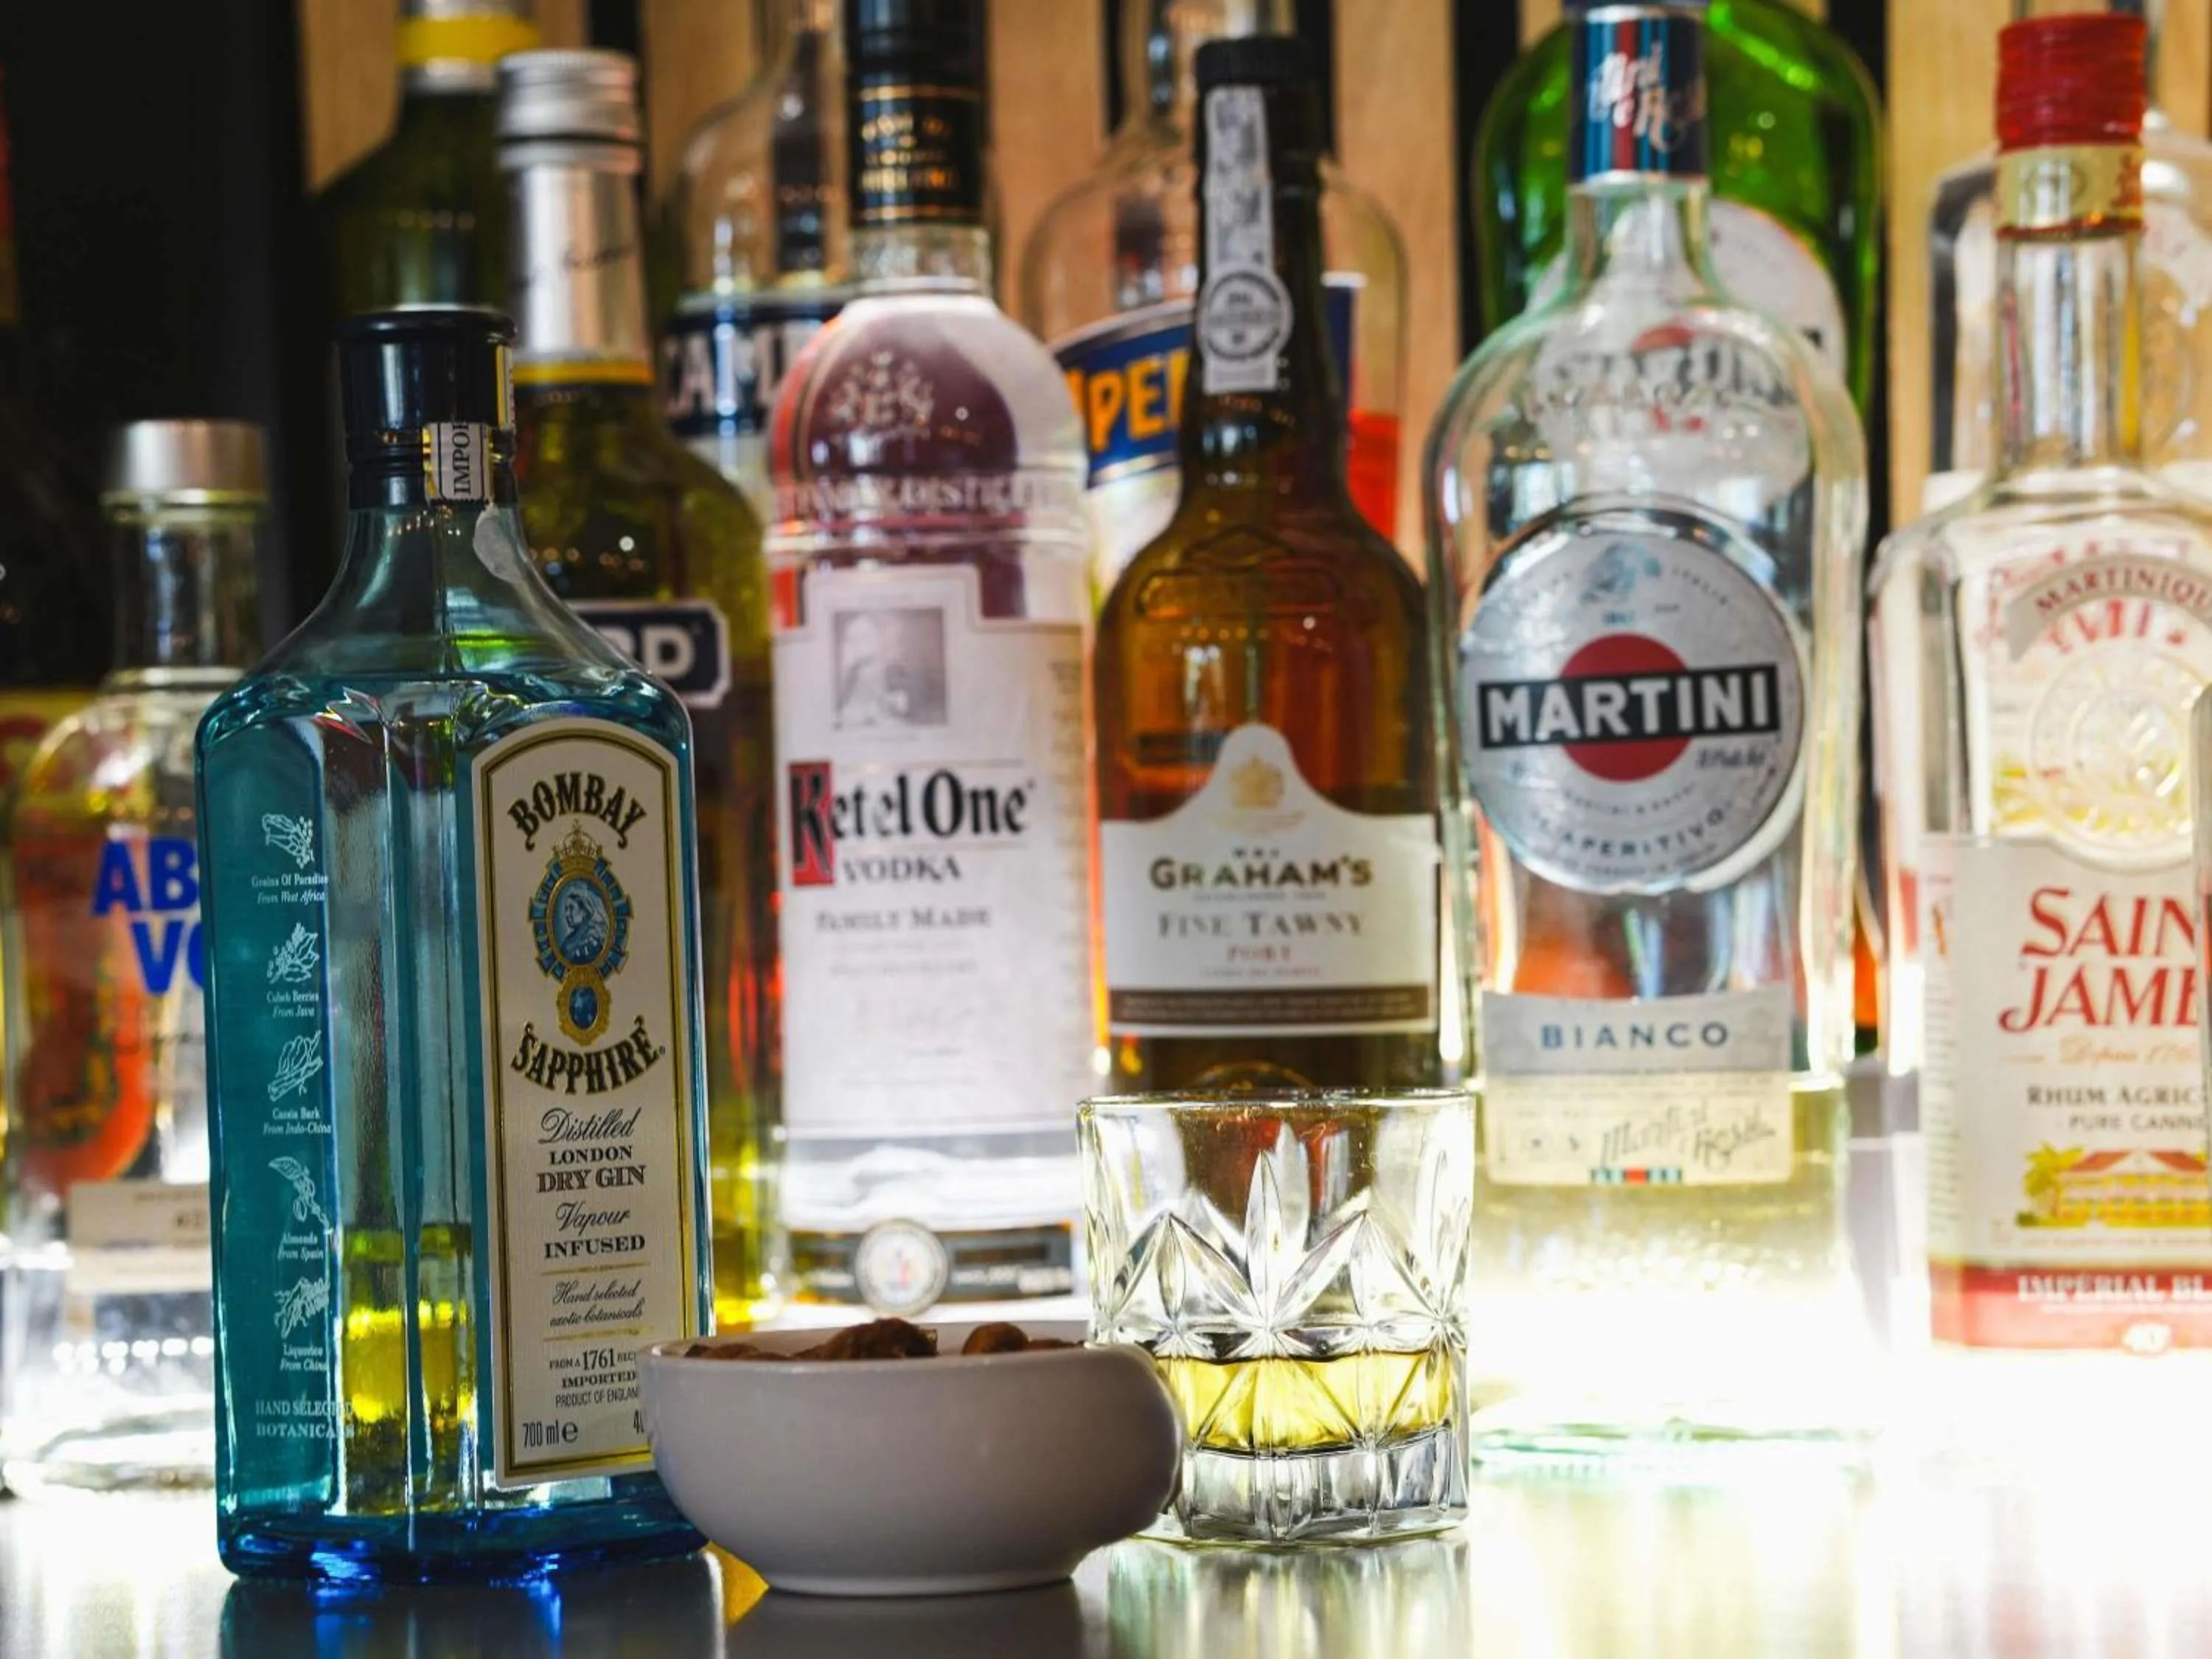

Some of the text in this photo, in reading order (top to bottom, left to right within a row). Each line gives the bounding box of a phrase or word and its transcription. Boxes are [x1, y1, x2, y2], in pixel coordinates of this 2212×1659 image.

[1485, 671, 1770, 745] MARTINI
[507, 771, 647, 852] BOMBAY
[791, 768, 1028, 876] Ketel One
[844, 855, 961, 883] VODKA
[1149, 855, 1374, 890] GRAHAM'S
[1540, 1020, 1730, 1049] BIANCO
[510, 1015, 661, 1096] SAPPHIRE
[2028, 1085, 2106, 1105] RHUM
[538, 1107, 642, 1144] Distilled
[550, 1145, 633, 1165] LONDON
[537, 1165, 647, 1193] DRY GIN
[556, 1200, 630, 1237] Vapour
[544, 1234, 645, 1259] INFUSED
[553, 1279, 641, 1304] Hand selected
[549, 1297, 645, 1327] exotic botanicals
[582, 1347, 616, 1371] 1761
[562, 1371, 636, 1388] IMPORTED
[255, 1399, 291, 1416] HAND
[555, 1391, 591, 1408] PRODUCT
[594, 1389, 604, 1405] OF
[522, 1420, 543, 1448] 700
[546, 1419, 560, 1445] ml
